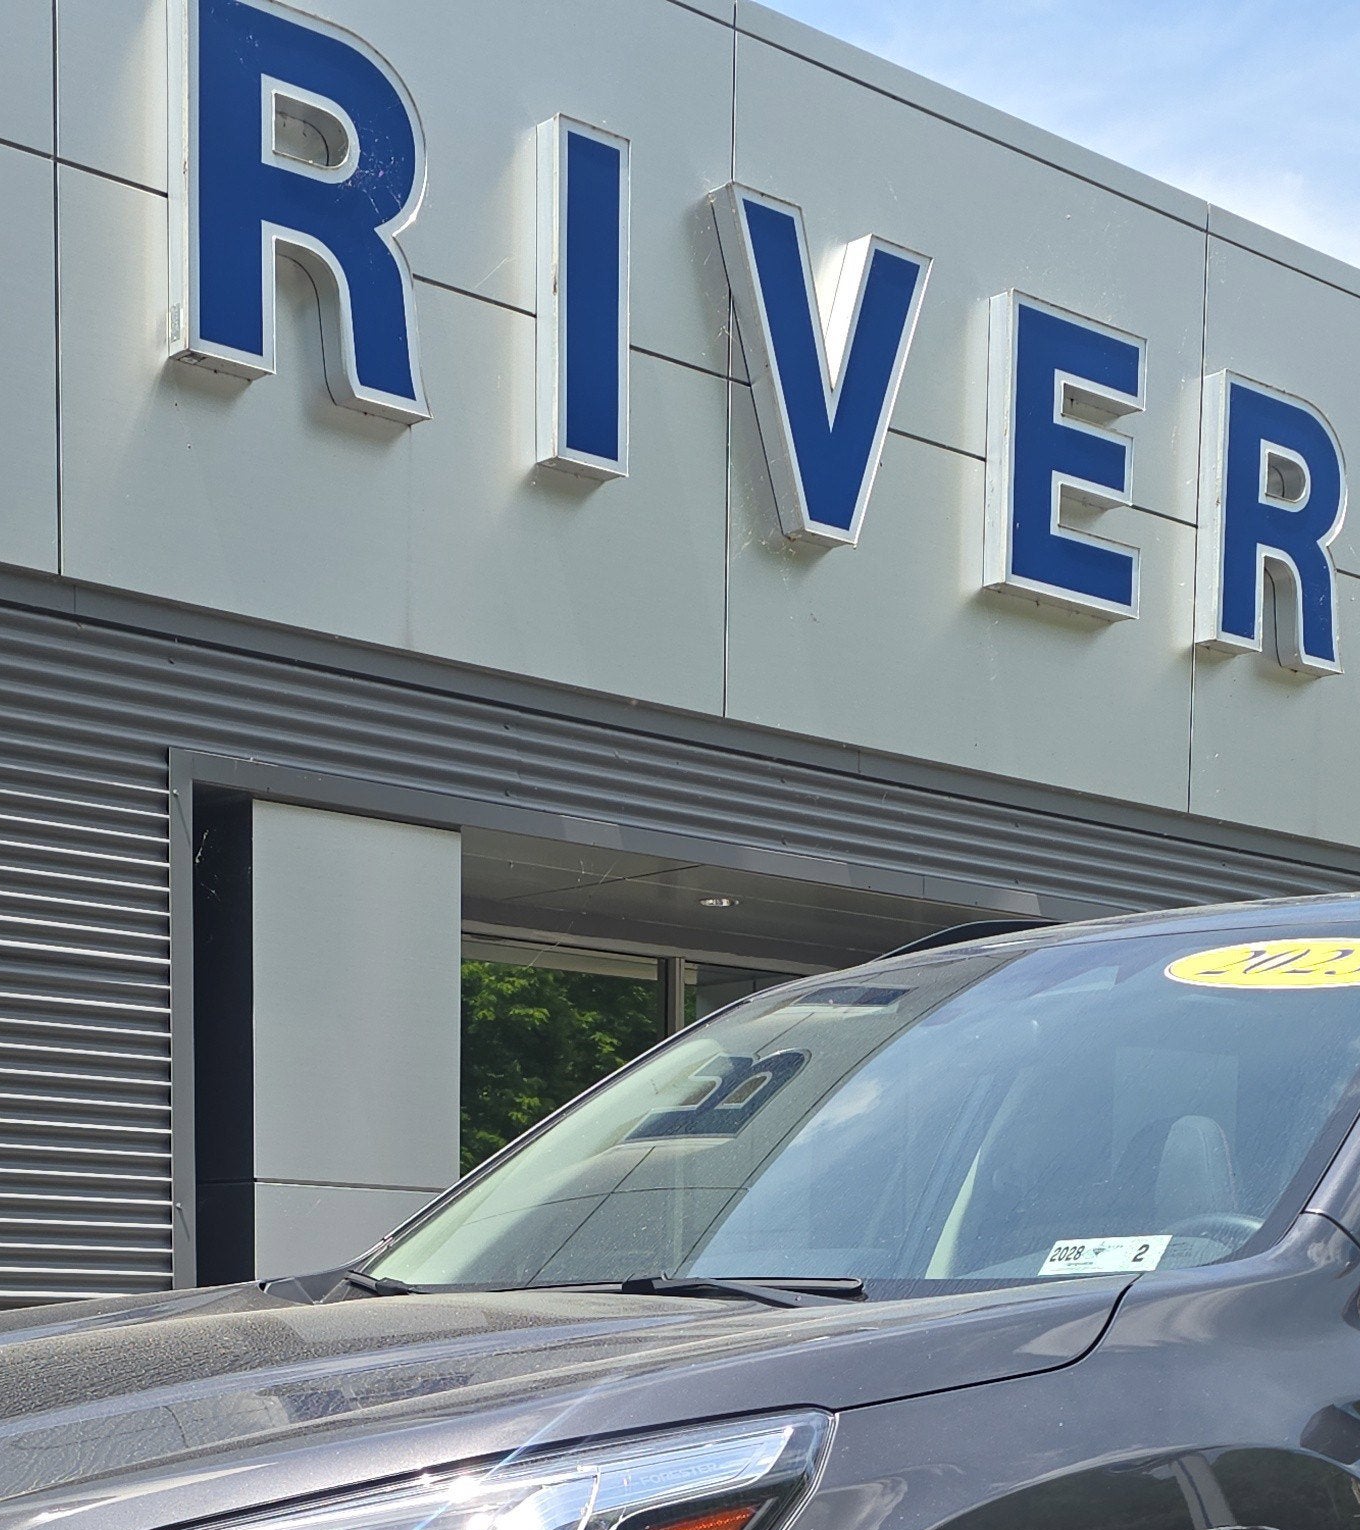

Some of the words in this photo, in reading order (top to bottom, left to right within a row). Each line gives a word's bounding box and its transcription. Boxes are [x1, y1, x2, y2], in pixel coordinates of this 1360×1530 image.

[168, 0, 1352, 678] RIVER
[1049, 1245, 1086, 1263] 2028
[1131, 1244, 1150, 1263] 2
[641, 1462, 720, 1486] FORESTER
